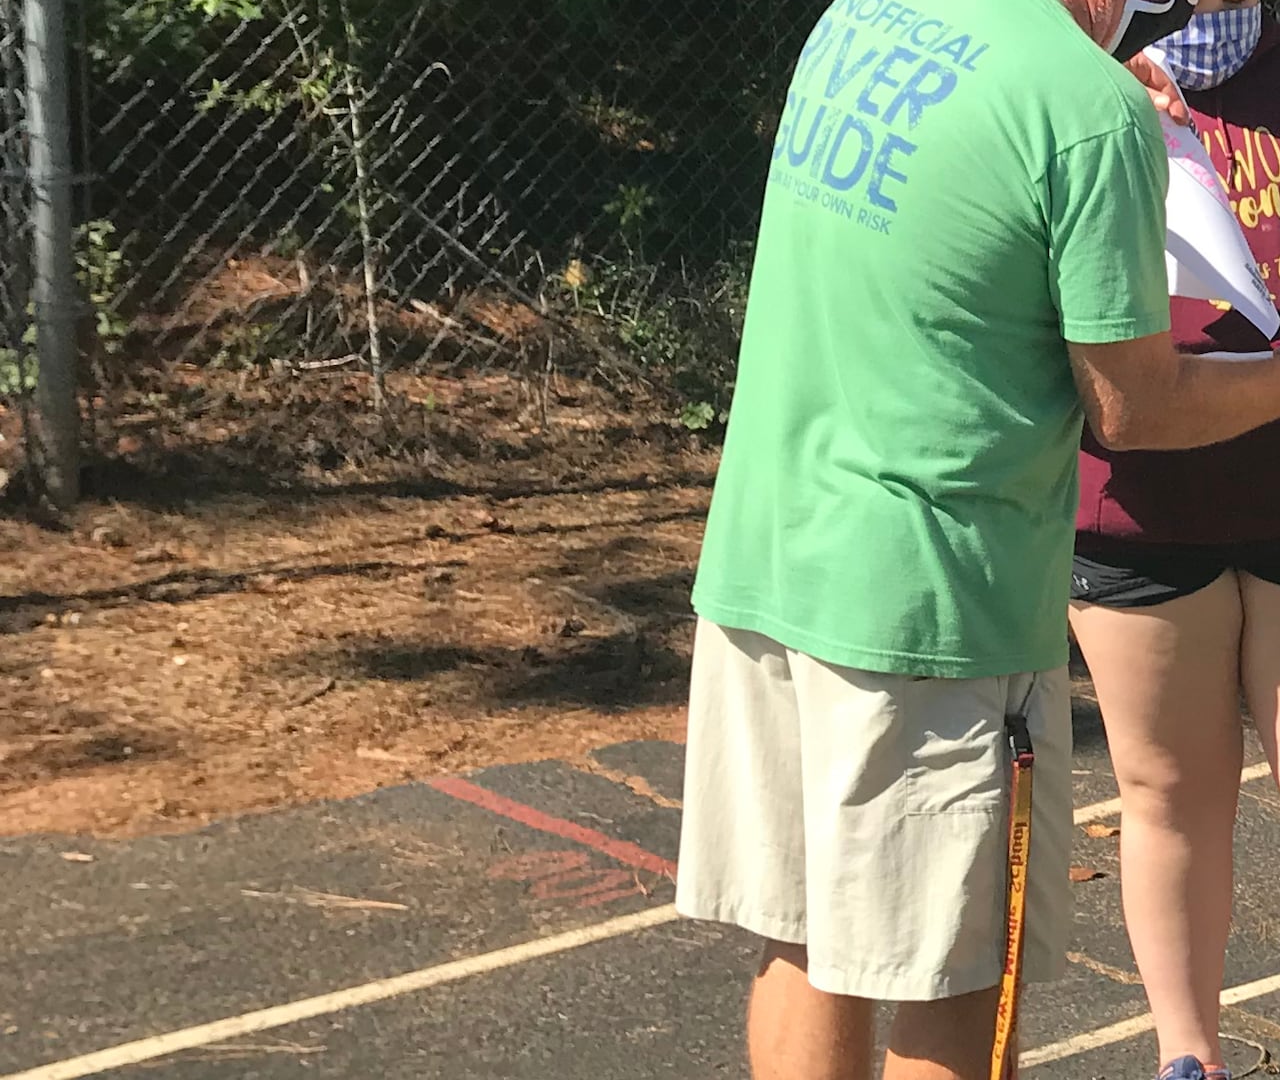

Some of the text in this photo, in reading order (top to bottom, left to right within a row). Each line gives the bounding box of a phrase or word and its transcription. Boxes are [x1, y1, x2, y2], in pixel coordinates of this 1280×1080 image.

[793, 177, 820, 203] YOUR
[821, 192, 853, 220] OWN
[857, 207, 893, 236] RISK
